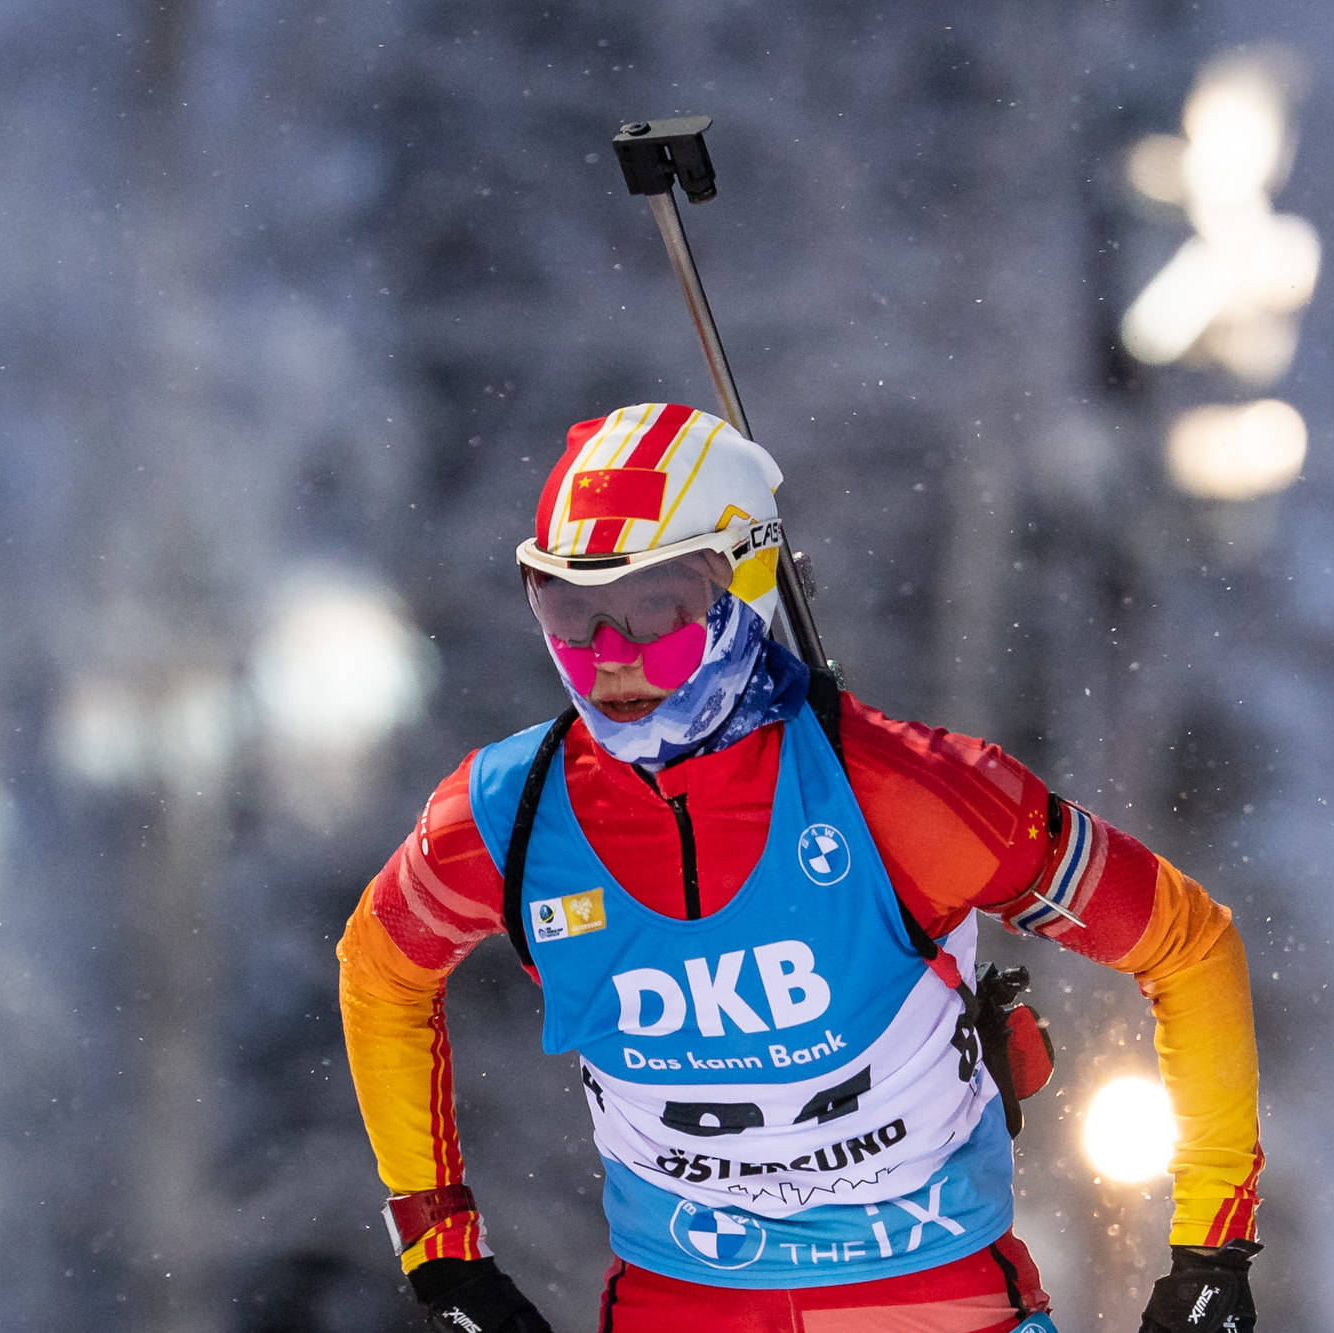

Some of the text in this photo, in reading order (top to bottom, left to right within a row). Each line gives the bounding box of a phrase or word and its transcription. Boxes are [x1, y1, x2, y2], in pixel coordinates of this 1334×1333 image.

[611, 939, 831, 1037] DKB
[623, 1029, 848, 1080] Das kann Bank
